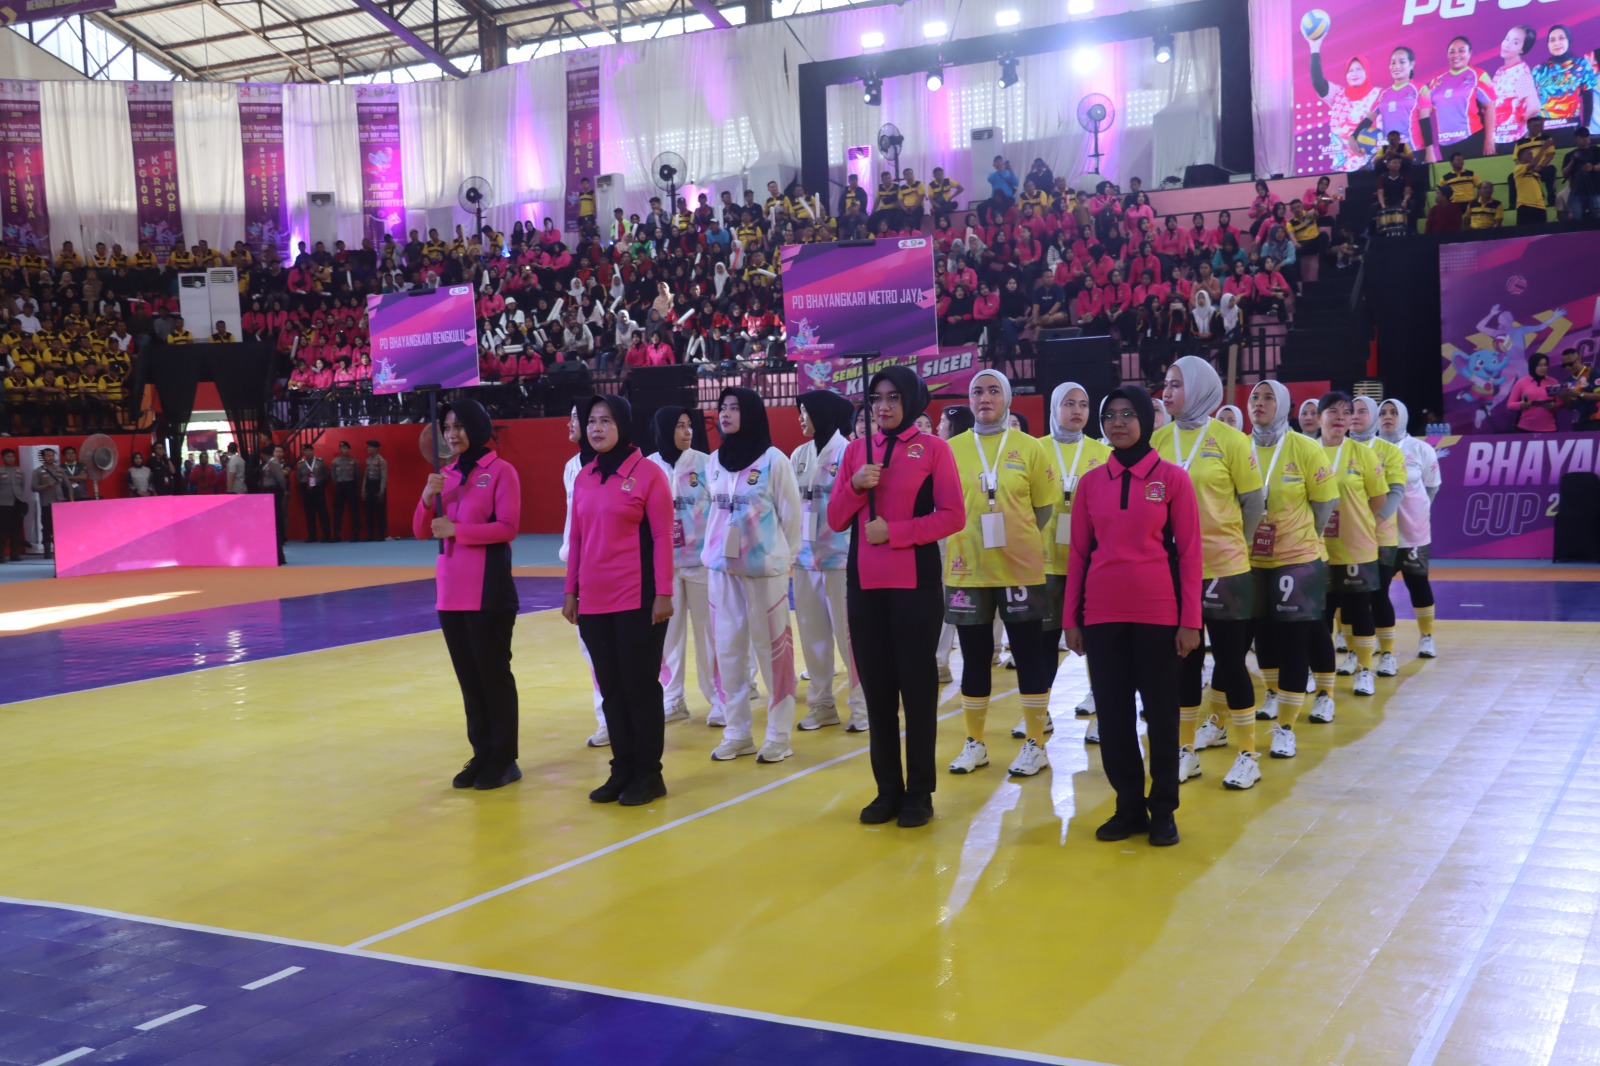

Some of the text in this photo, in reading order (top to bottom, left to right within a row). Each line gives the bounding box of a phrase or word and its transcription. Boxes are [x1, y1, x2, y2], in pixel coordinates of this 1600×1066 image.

[586, 123, 594, 168] SIGER
[1438, 131, 1466, 139] YOVAN
[151, 156, 163, 207] KORPS
[792, 288, 924, 309] PD BHAYANGKARI METRO JAYA
[380, 329, 466, 350] PD BHAYANGKARI BENGKULU
[922, 352, 973, 378] SIGER
[1463, 438, 1600, 487] BHAYA
[1463, 492, 1541, 536] CUP
[1279, 575, 1294, 602] 9
